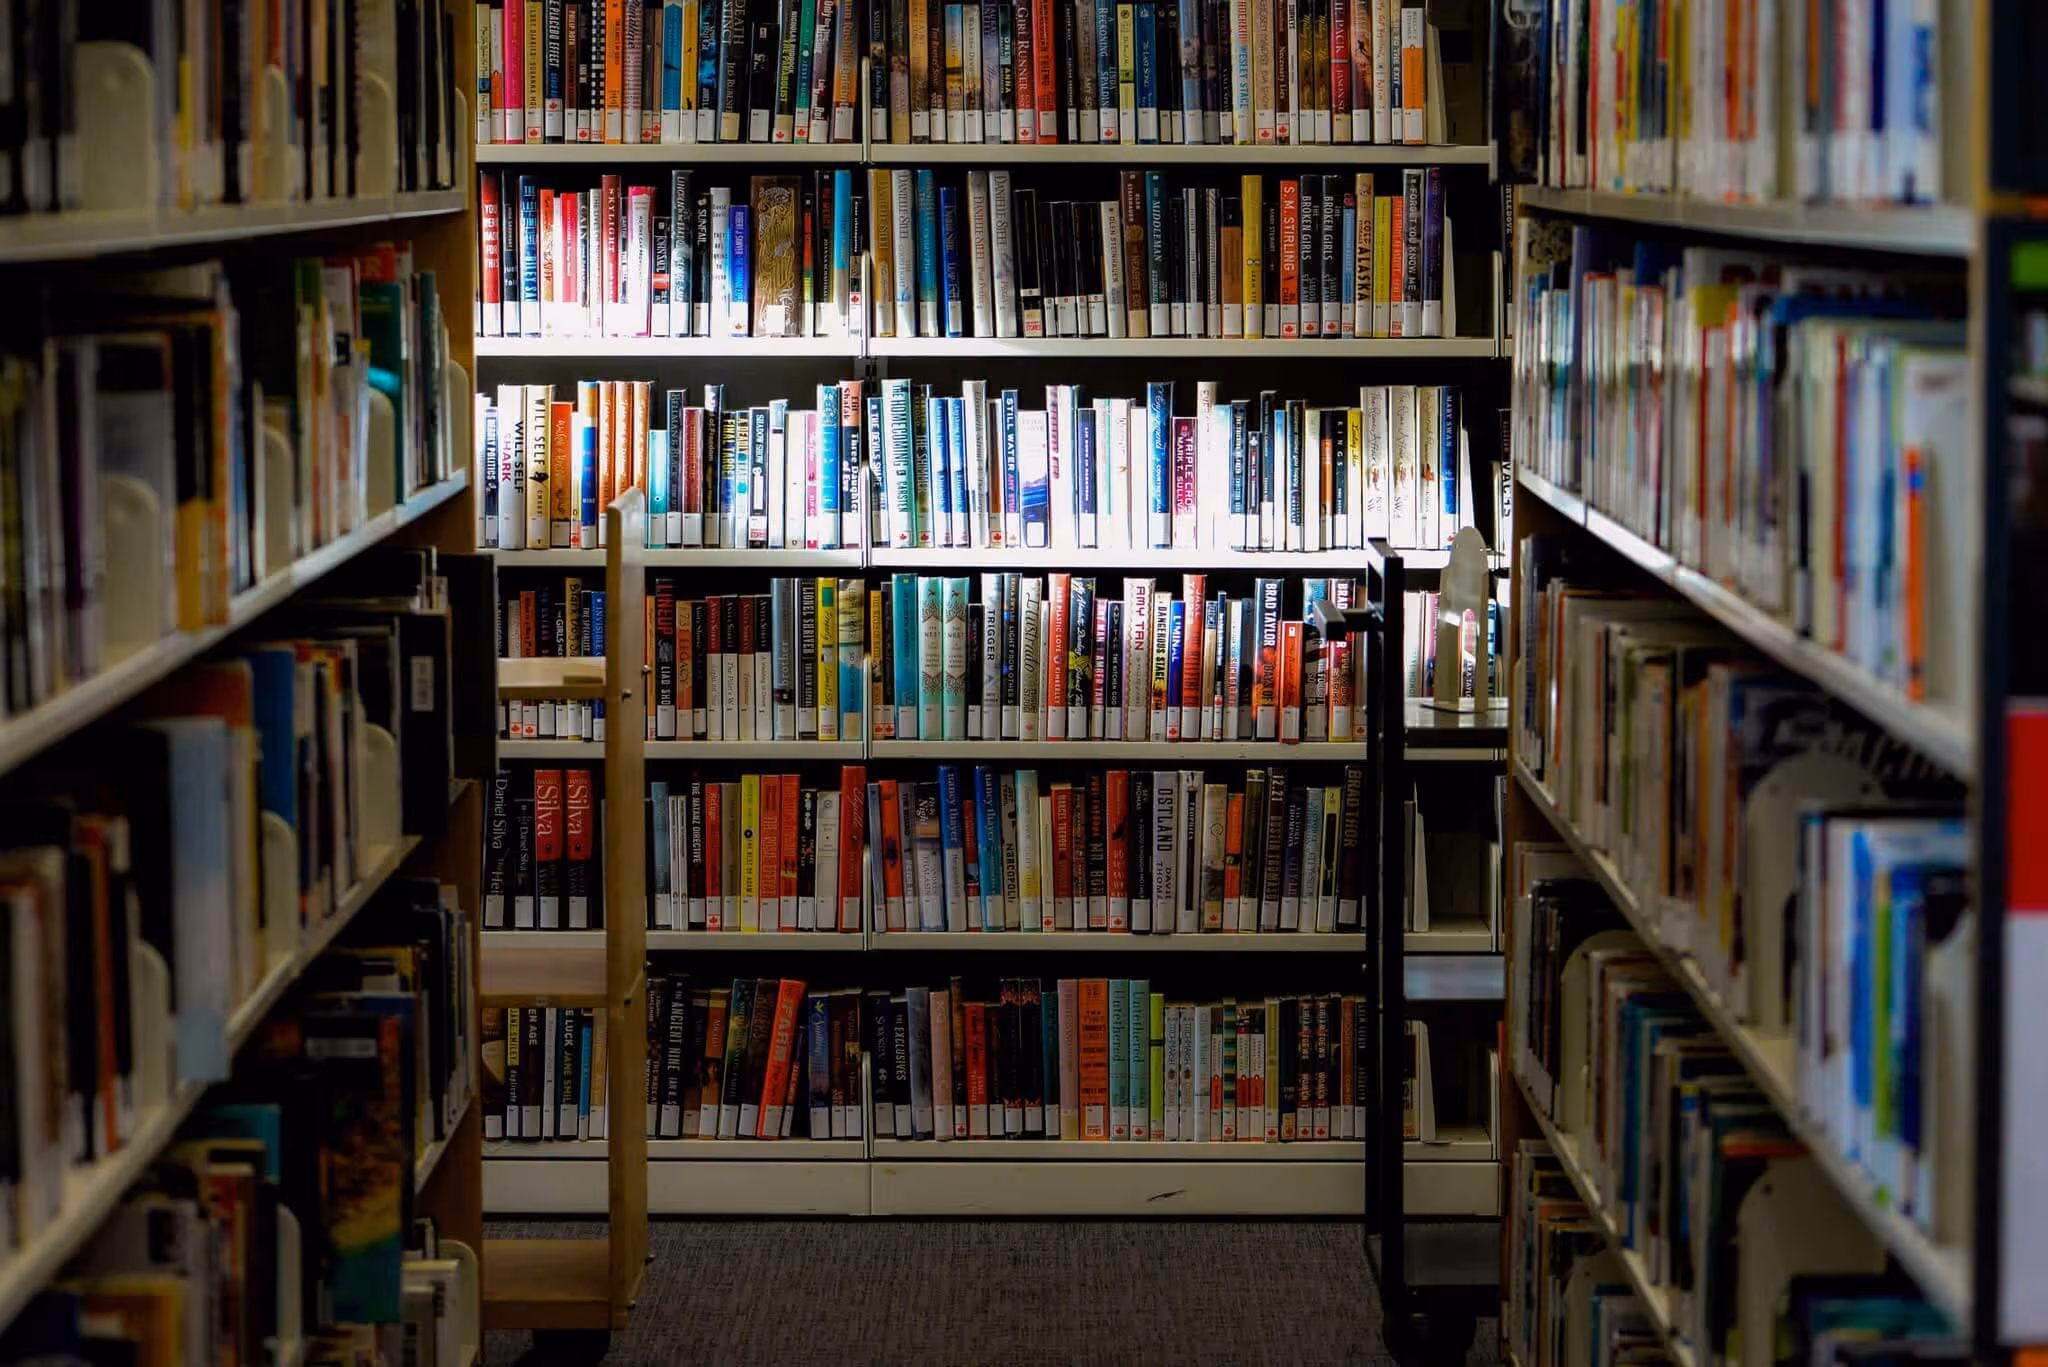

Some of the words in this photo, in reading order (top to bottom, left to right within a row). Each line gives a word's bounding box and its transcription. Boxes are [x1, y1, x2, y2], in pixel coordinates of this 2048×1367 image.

[733, 0, 746, 46] DEATH
[1099, 7, 1109, 57] RECKONING
[549, 41, 561, 67] EFFECT
[1018, 40, 1031, 91] RUNNER
[994, 175, 1008, 220] DANIELLE
[1283, 186, 1296, 200] S.
[1410, 187, 1418, 224] FORGET
[607, 187, 617, 254] SKYLIGHT
[696, 208, 708, 248] SUNFAIL
[1109, 215, 1117, 235] OLEN
[1301, 195, 1313, 231] BROKEN
[1323, 195, 1336, 231] BROKEN
[656, 234, 669, 254] JOHN
[1152, 199, 1164, 262] MIDDLEMAN
[1283, 216, 1296, 273] STIRLING
[1301, 233, 1313, 262] GIRLS
[1323, 233, 1336, 262] GIRLS
[1409, 225, 1417, 245] YOU
[656, 254, 669, 274] SAUL
[1111, 236, 1119, 283] STEINHAUER
[1358, 245, 1372, 302] ALASKA
[1408, 246, 1418, 274] KNOW
[1408, 276, 1418, 292] ME
[842, 387, 851, 421] Shafak
[850, 396, 860, 413] Elif
[892, 384, 904, 399] THE
[534, 398, 547, 432] WILL
[756, 414, 765, 444] SHADOW
[872, 413, 881, 428] THE
[1006, 397, 1016, 430] STILL
[1151, 394, 1165, 451] Engagements
[513, 420, 525, 458] WILL
[723, 419, 736, 445] FINAL
[737, 426, 750, 455] DEADLY
[851, 433, 860, 463] Three
[890, 400, 909, 467] HOMECOMING
[1176, 436, 1184, 462] MARK
[1445, 423, 1454, 449] SWAN
[486, 447, 498, 481] POLITICS
[501, 432, 513, 483] SHARK
[534, 436, 547, 467] SELF
[723, 447, 736, 481] TARGET
[756, 445, 765, 466] SHOW
[843, 460, 852, 471] of
[1007, 433, 1016, 472] WATER
[1176, 464, 1184, 472] T.
[1184, 436, 1195, 480] TRIPLE
[513, 461, 525, 495] SELF
[843, 473, 852, 491] Eve
[897, 480, 909, 513] CARSTEN
[801, 586, 817, 617] LIONEL
[1135, 585, 1147, 618] AMY
[1264, 583, 1278, 610] BRAD
[1336, 583, 1350, 610] BRAD
[555, 618, 565, 644] GIRLS
[596, 606, 605, 651] INVISIBLE
[801, 618, 817, 655] SHRIVER
[987, 609, 997, 661] TRIGGER
[1009, 625, 1018, 648] LIGHT
[1024, 592, 1042, 674] Ilustrado
[1135, 621, 1147, 652] TAN
[1171, 614, 1183, 664] LIMINAL
[1264, 611, 1278, 647] TAYLOR
[1095, 655, 1107, 686] AMBER
[495, 778, 509, 818] Daniel
[947, 773, 961, 806] nancy
[984, 773, 995, 807] nancy
[1345, 768, 1364, 810] BRAD
[537, 784, 562, 838] Silva
[569, 784, 592, 836] Silva
[950, 808, 964, 843] thayer
[987, 808, 1000, 843] thayer
[1156, 787, 1175, 853] OSTLAND
[492, 819, 507, 850] Silva
[691, 826, 703, 865] DIRECTIVE
[1343, 811, 1361, 850] THOR
[564, 1018, 575, 1048] LUCK
[670, 1001, 687, 1045] ANCIENT
[668, 1046, 682, 1072] NINE
[894, 1026, 907, 1081] EXCLUSIVES
